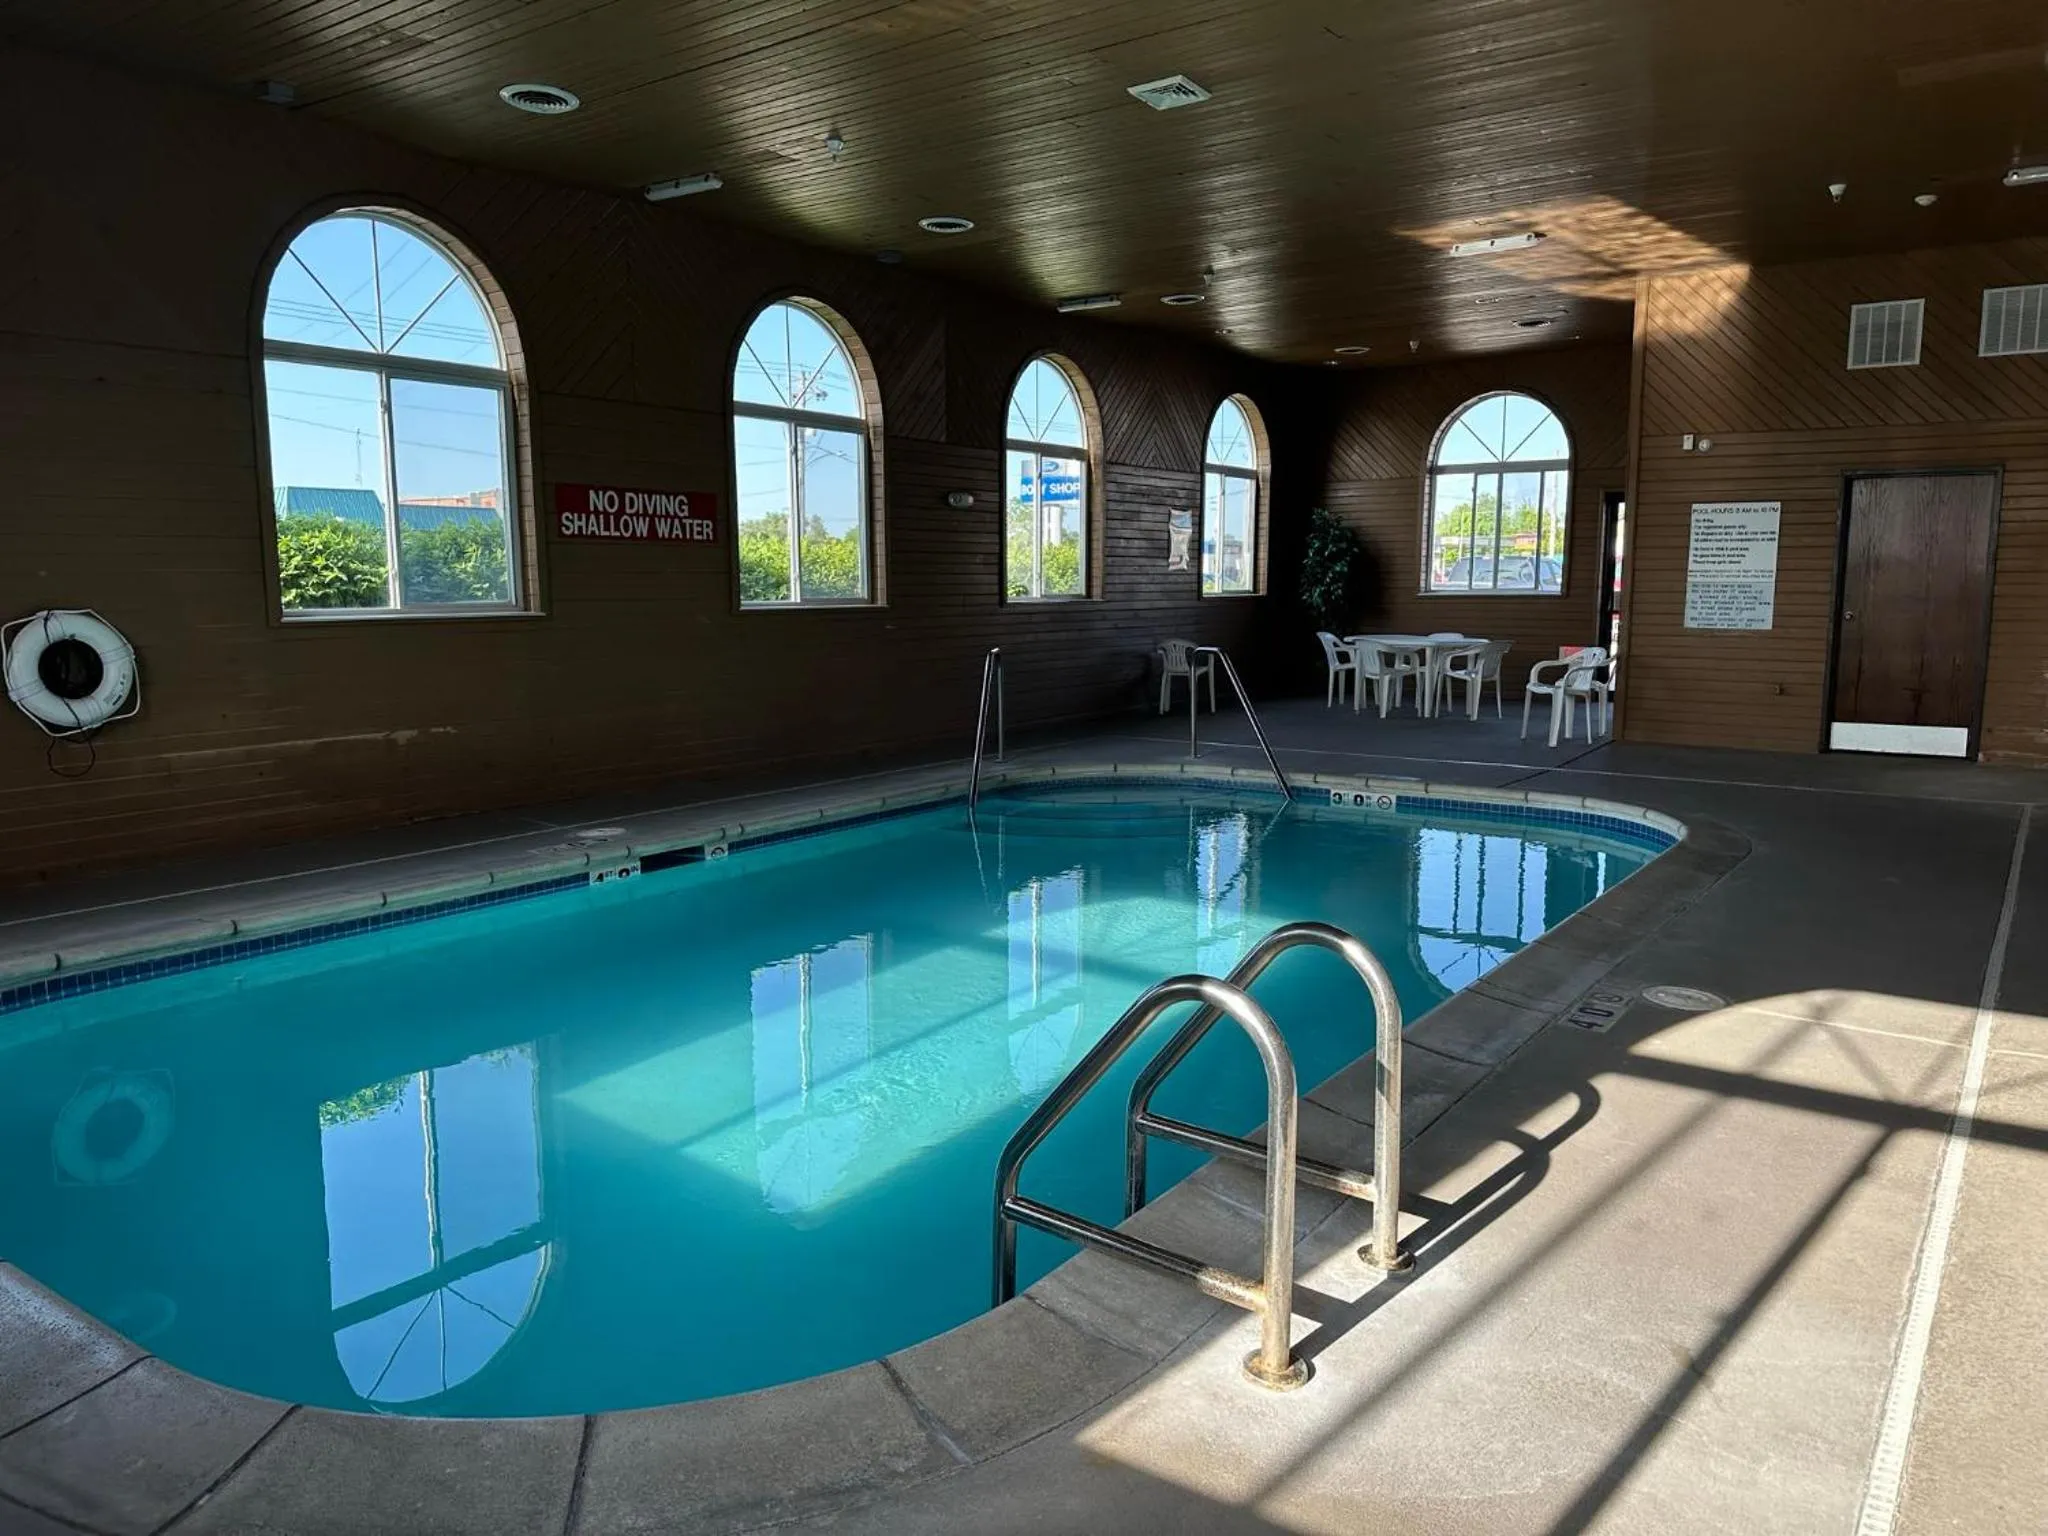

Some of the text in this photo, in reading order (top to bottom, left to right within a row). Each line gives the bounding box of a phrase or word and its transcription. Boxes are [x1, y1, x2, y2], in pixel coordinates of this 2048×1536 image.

[1049, 482, 1080, 495] SHOP
[589, 490, 689, 517] NO DIVING
[561, 512, 714, 541] SHALLOW WATER
